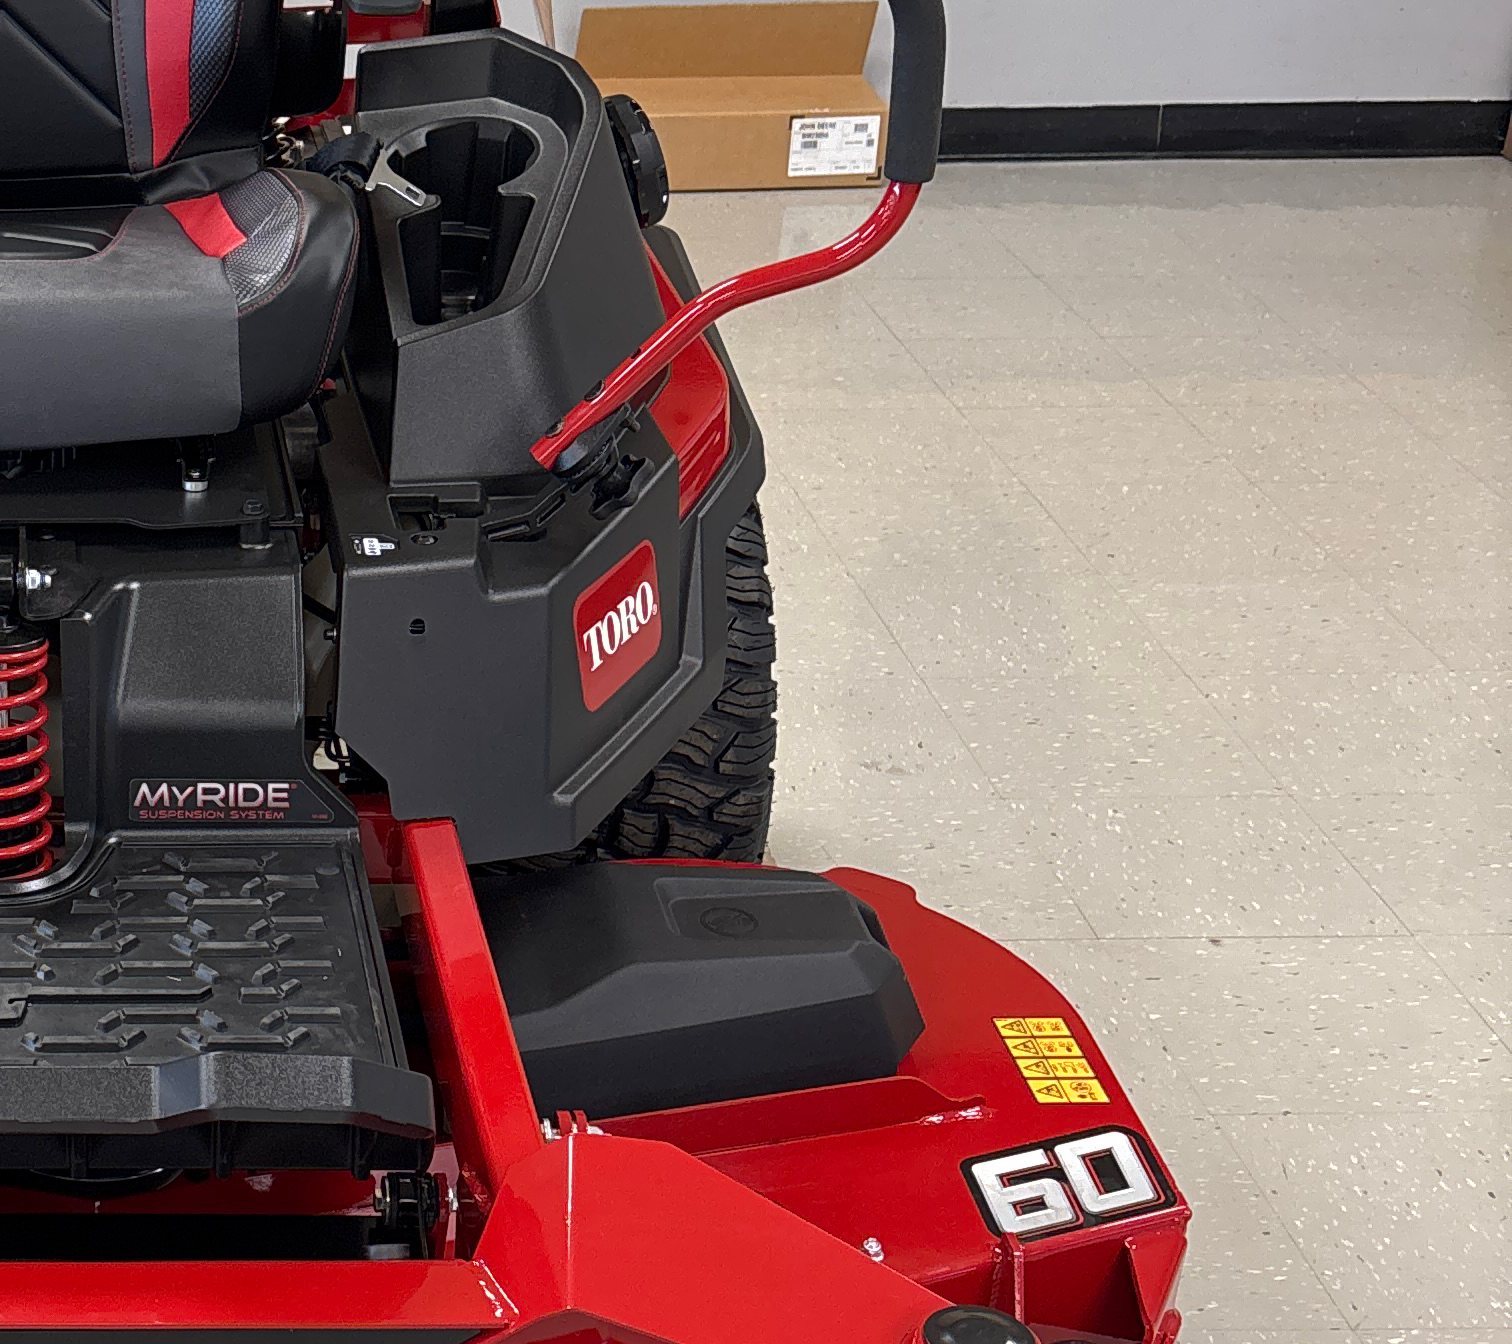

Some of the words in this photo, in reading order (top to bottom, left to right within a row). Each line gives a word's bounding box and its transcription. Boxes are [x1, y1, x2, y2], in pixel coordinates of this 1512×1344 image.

[583, 581, 654, 672] TORO
[139, 809, 225, 820] SUSPENSION
[229, 809, 285, 820] SYSTEM
[970, 1130, 1159, 1234] 60
